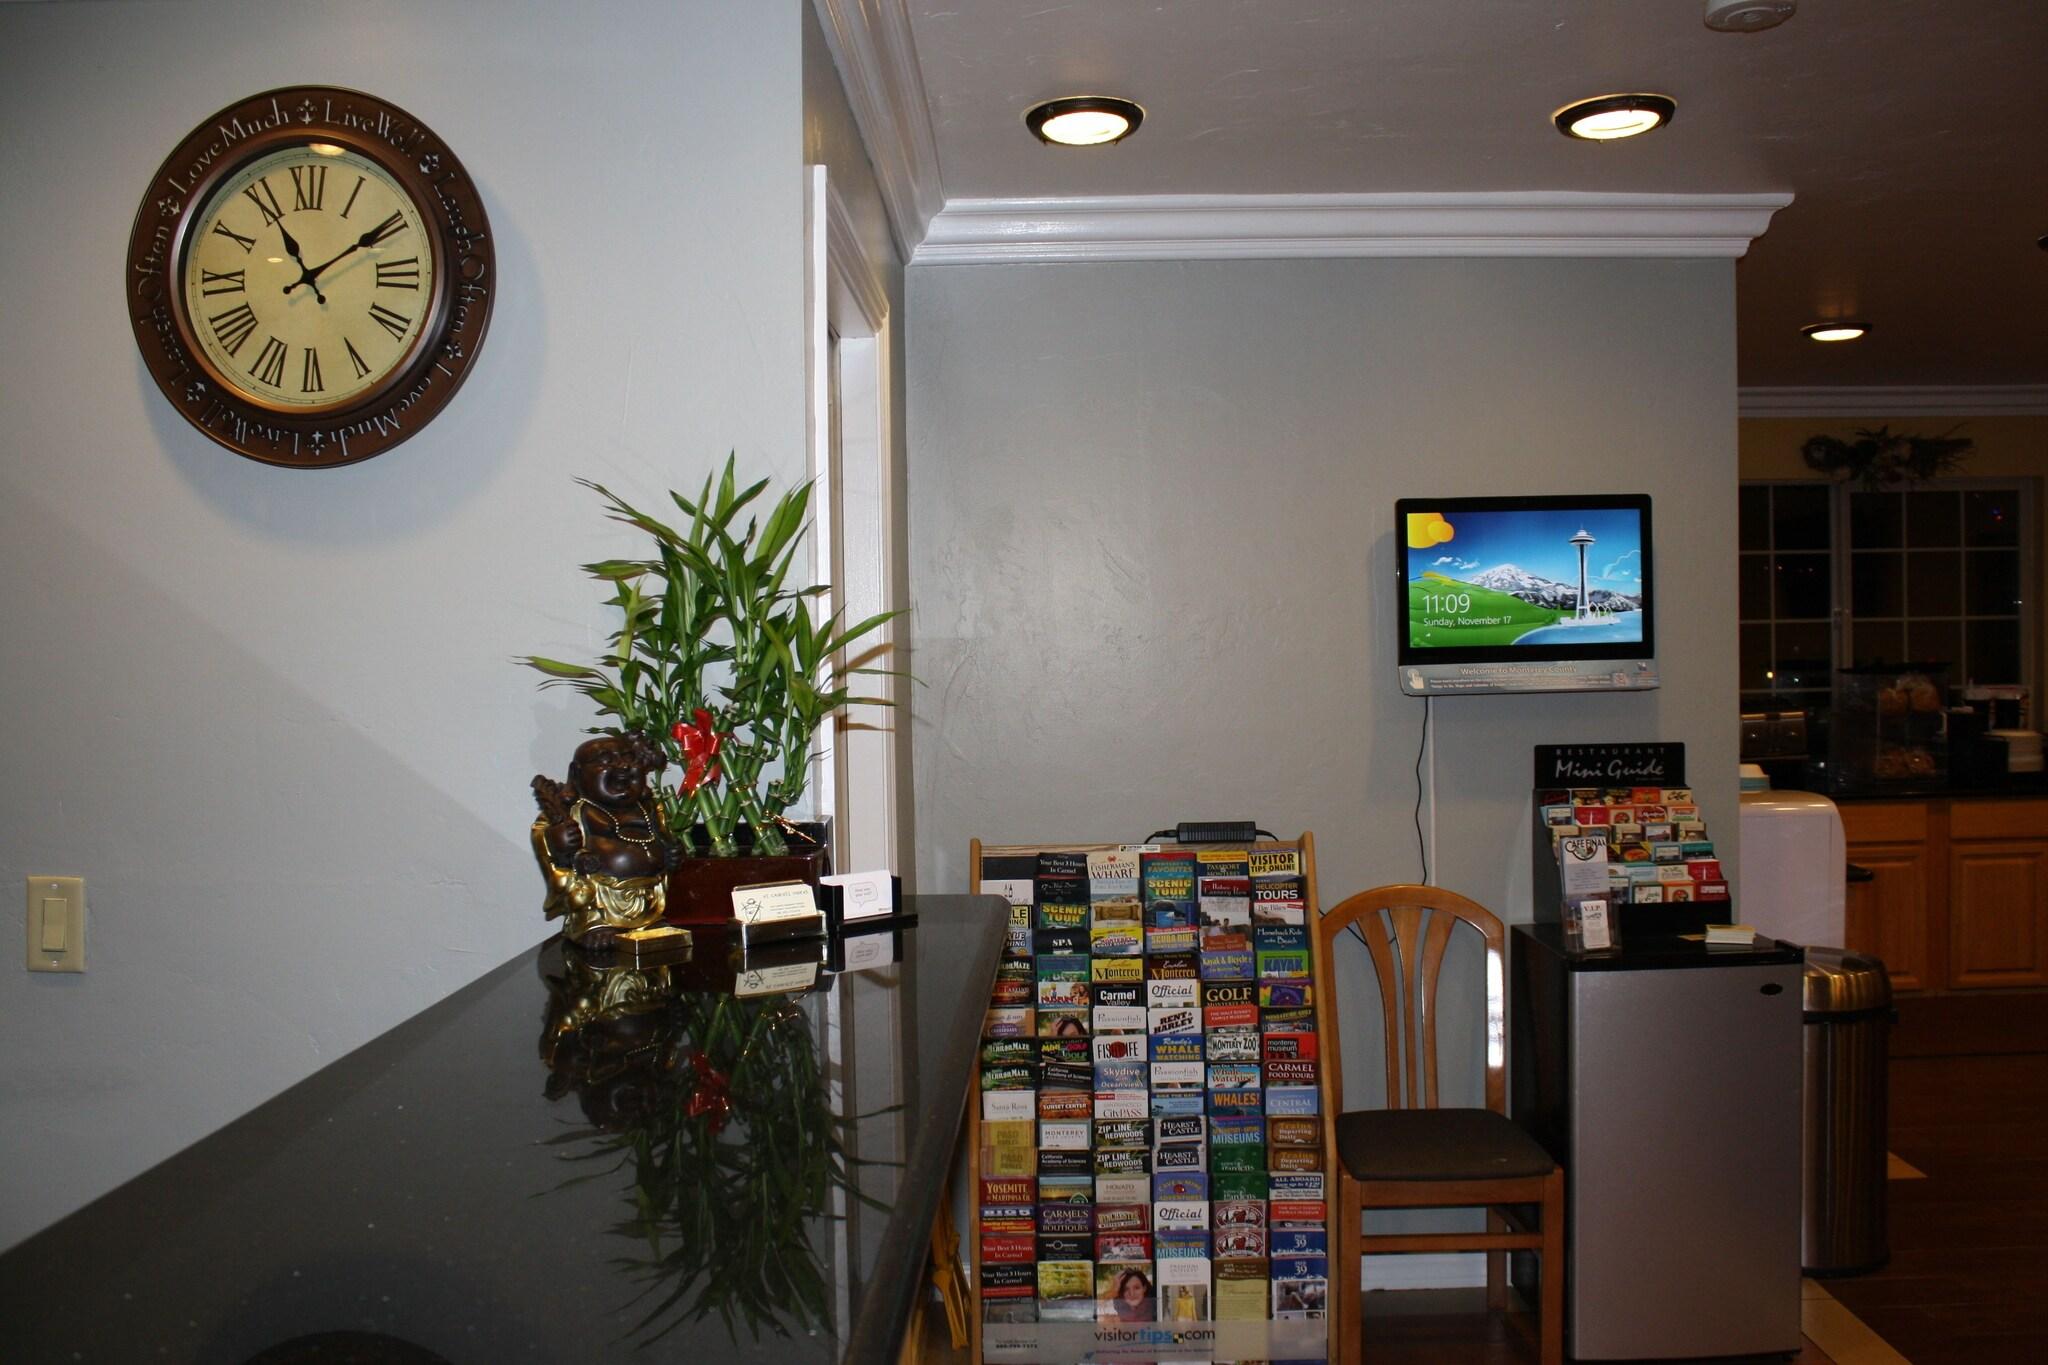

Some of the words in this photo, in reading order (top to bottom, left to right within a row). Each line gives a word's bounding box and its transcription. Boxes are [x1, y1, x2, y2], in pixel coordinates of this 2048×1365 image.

[325, 100, 374, 132] Live
[289, 165, 328, 211] XII
[243, 176, 285, 227] XI
[340, 176, 366, 219] I
[212, 219, 256, 254] X
[376, 256, 420, 291] III
[202, 268, 245, 298] IX
[248, 335, 288, 388] VII
[344, 337, 372, 379] V
[300, 346, 325, 392] VI
[1423, 594, 1471, 614] 11:09
[1423, 617, 1455, 628] Sunday,
[1457, 615, 1501, 625] November
[1504, 615, 1512, 624] 17
[1556, 747, 1664, 756] RESTAURANT
[1555, 759, 1603, 779] Mini
[1607, 758, 1664, 780] Guide
[1250, 854, 1294, 866] VISITOR
[1092, 868, 1135, 879] WHARF
[1148, 879, 1192, 888] SCENIC
[1154, 887, 1187, 896] TOUR
[1255, 889, 1299, 900] TOURS
[1042, 905, 1086, 915] SCENIC
[1047, 914, 1081, 922] TOUR
[1052, 938, 1073, 947] SPA
[1095, 968, 1140, 980] Monterey
[1150, 968, 1196, 980] Monterey
[1100, 990, 1136, 1000] Carmel
[1152, 984, 1193, 998] Official
[1206, 987, 1252, 1002] GOLF
[1159, 1011, 1187, 1024] RENT
[1153, 1017, 1194, 1034] HARLEY
[1212, 1038, 1242, 1050] MONTEREY
[1243, 1037, 1257, 1051] ZOO
[1267, 1039, 1297, 1047] monterey
[1155, 1044, 1200, 1054] WHALE
[1103, 1067, 1140, 1077] Skydive
[1268, 1063, 1314, 1072] CARMEL
[1212, 1074, 1256, 1083] Watching
[1214, 1093, 1260, 1106] WHALES!
[1103, 1109, 1142, 1118] CityPASS
[1097, 1125, 1112, 1134] ZIP
[1113, 1123, 1131, 1131] LINE
[1163, 1121, 1196, 1129] HEARST
[1105, 1131, 1144, 1140] REDWOODS
[1168, 1127, 1200, 1135] CASTLE
[1212, 1132, 1260, 1144] MUSEUMS
[1096, 1154, 1111, 1162] ZIP
[1112, 1152, 1131, 1160] LINE
[1160, 1151, 1193, 1159] HEARST
[1103, 1160, 1143, 1168] REDWOODS
[1165, 1157, 1198, 1165] CASTLE
[987, 1183, 1028, 1193] YOSEMITE
[1159, 1207, 1203, 1221] Official
[1043, 1224, 1089, 1232] BOUTIQUES
[1294, 1238, 1307, 1248] 39
[1156, 1247, 1206, 1258] MUSEUMS
[1294, 1265, 1308, 1275] 39
